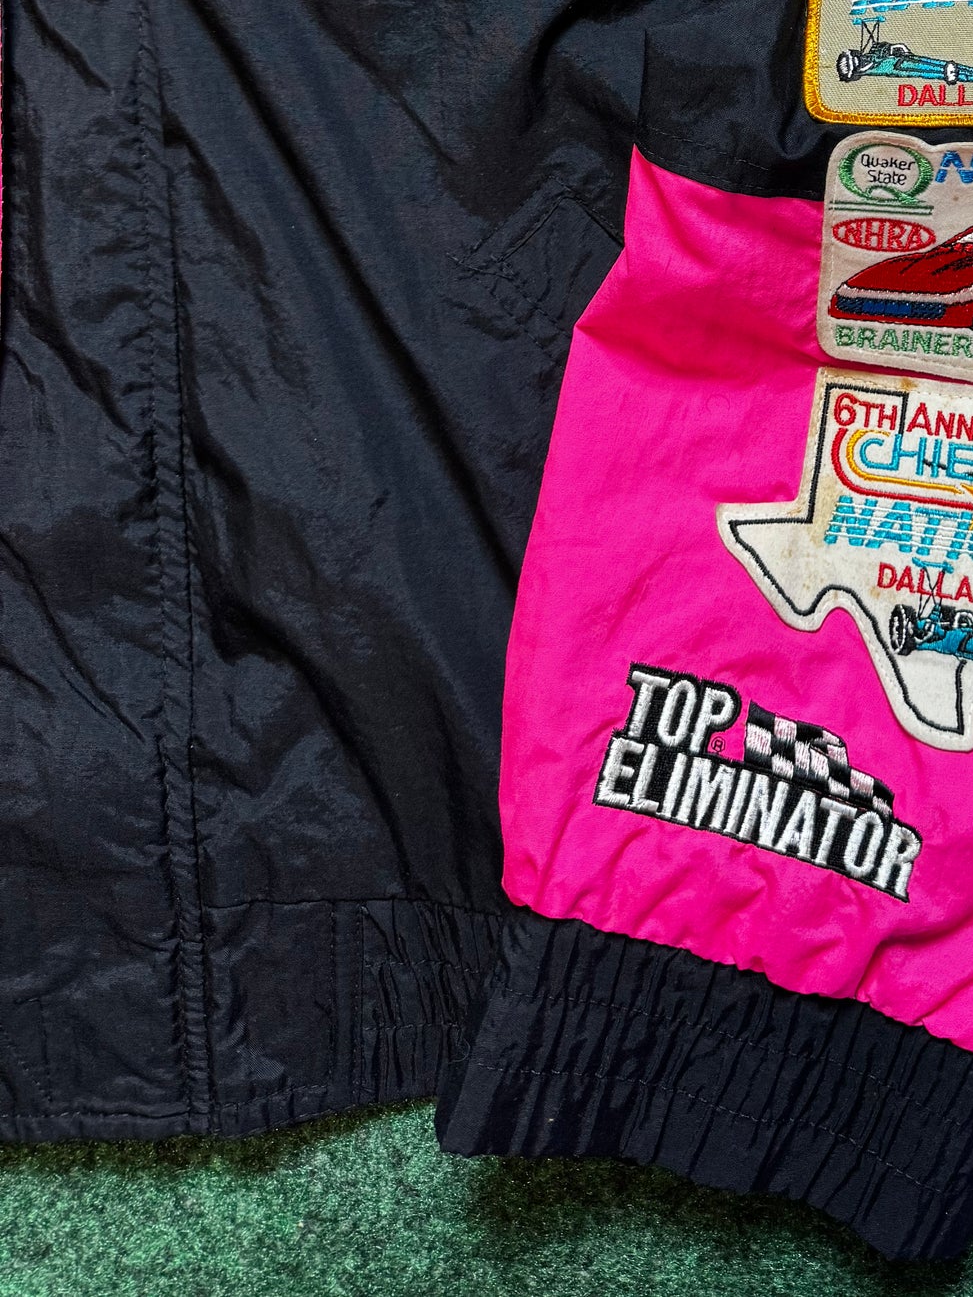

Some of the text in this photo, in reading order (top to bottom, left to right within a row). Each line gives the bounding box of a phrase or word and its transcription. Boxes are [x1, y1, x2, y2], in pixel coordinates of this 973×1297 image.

[860, 153, 916, 171] Quaker
[867, 169, 908, 187] State
[843, 220, 928, 251] NHRA
[833, 392, 897, 431] 6TH
[630, 670, 735, 752] TOP
[597, 738, 924, 898] ELIMINATOR
